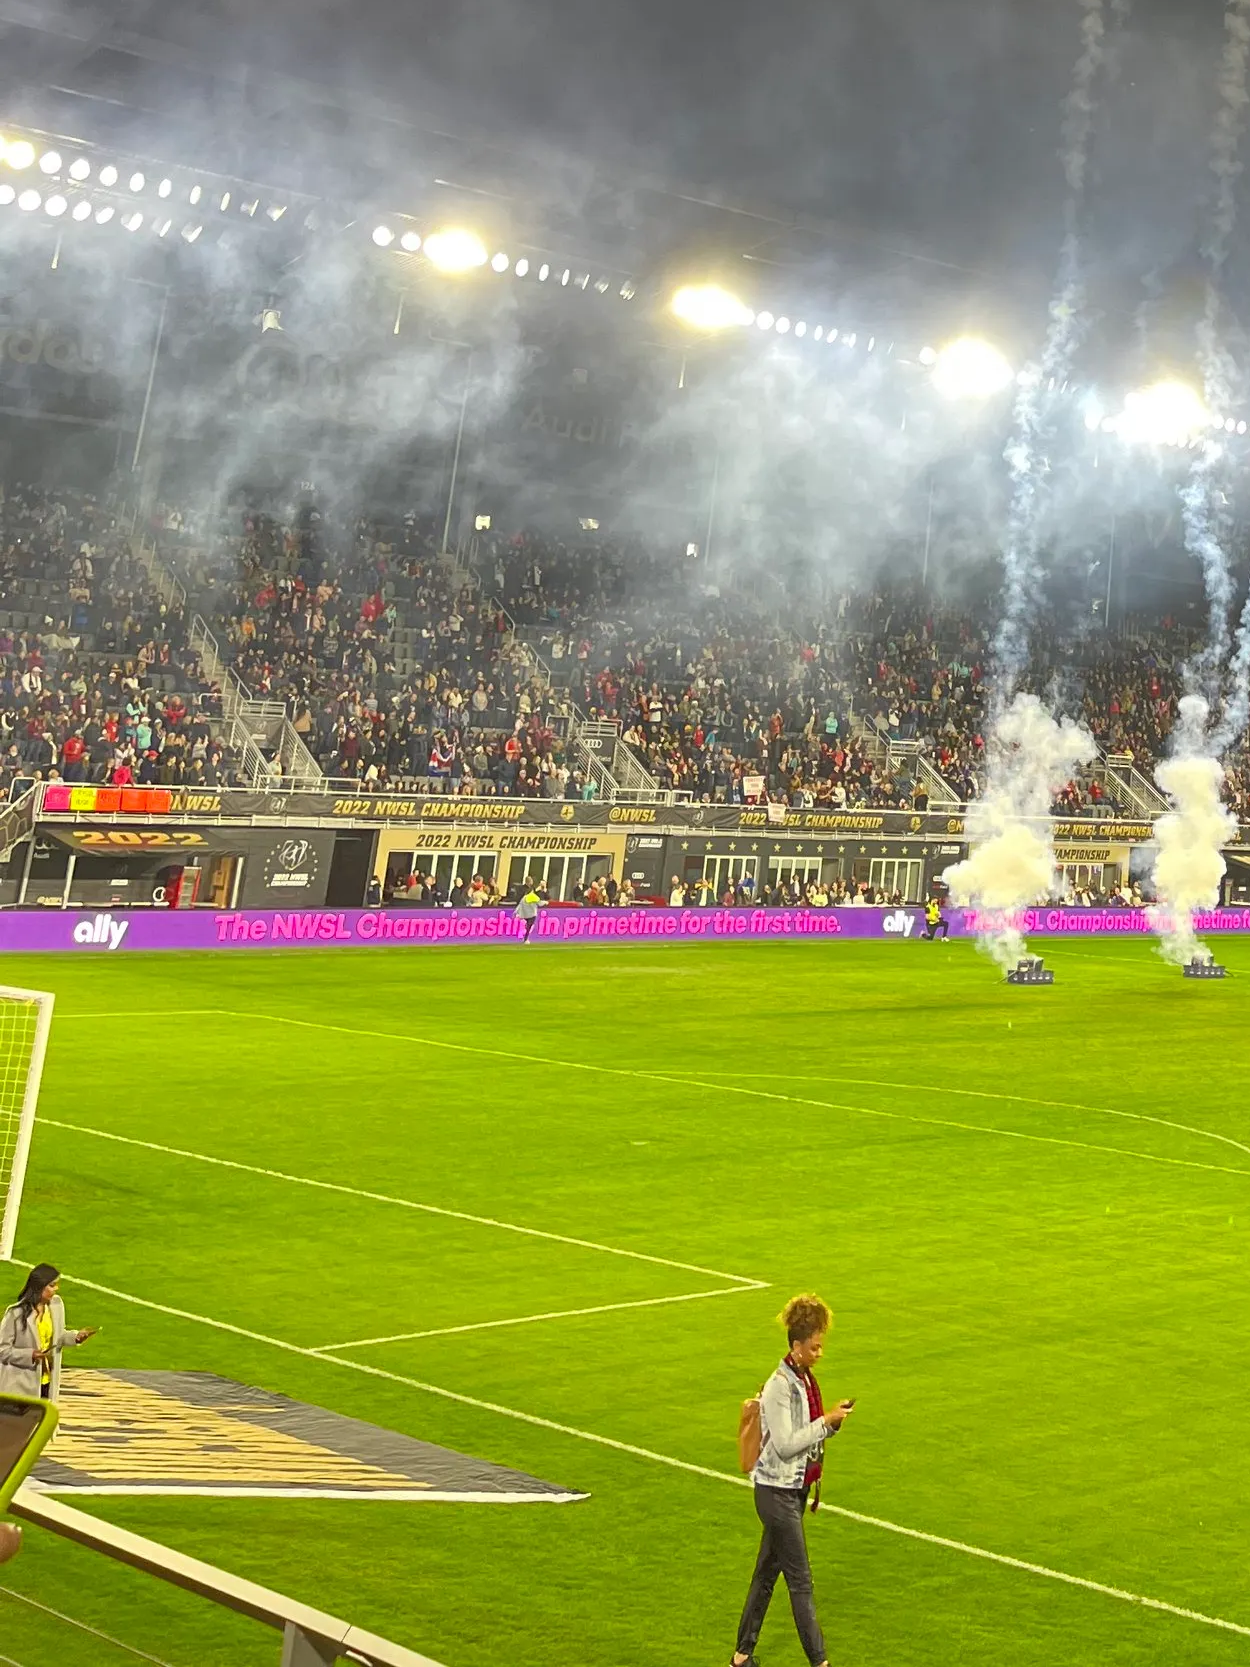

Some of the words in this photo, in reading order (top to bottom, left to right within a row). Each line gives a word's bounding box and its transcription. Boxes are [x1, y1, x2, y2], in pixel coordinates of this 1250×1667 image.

[171, 795, 221, 811] NWSL
[333, 800, 371, 814] 2022
[374, 801, 416, 816] NWSL
[421, 802, 525, 819] CHAMPIONSHIP
[609, 807, 656, 822] @NWSL
[739, 812, 767, 825] 2022
[804, 814, 884, 829] CHAMPIONSHIP
[73, 831, 209, 846] 2022
[1072, 824, 1097, 836] NWSL
[1100, 825, 1153, 837] CHAMPIONSH
[416, 834, 452, 847] 2022
[455, 835, 494, 848] NWSL
[500, 836, 597, 850] CHAMPIONSHIP
[1054, 849, 1111, 861] AMPIONSHIP
[215, 913, 267, 941] The
[271, 913, 351, 939] NWSL
[538, 910, 560, 935] in
[563, 910, 677, 939] primetime
[680, 910, 711, 933] for
[713, 910, 747, 933] the
[750, 909, 791, 933] first
[794, 910, 841, 932] time.
[883, 910, 914, 937] ally
[73, 914, 129, 950] ally
